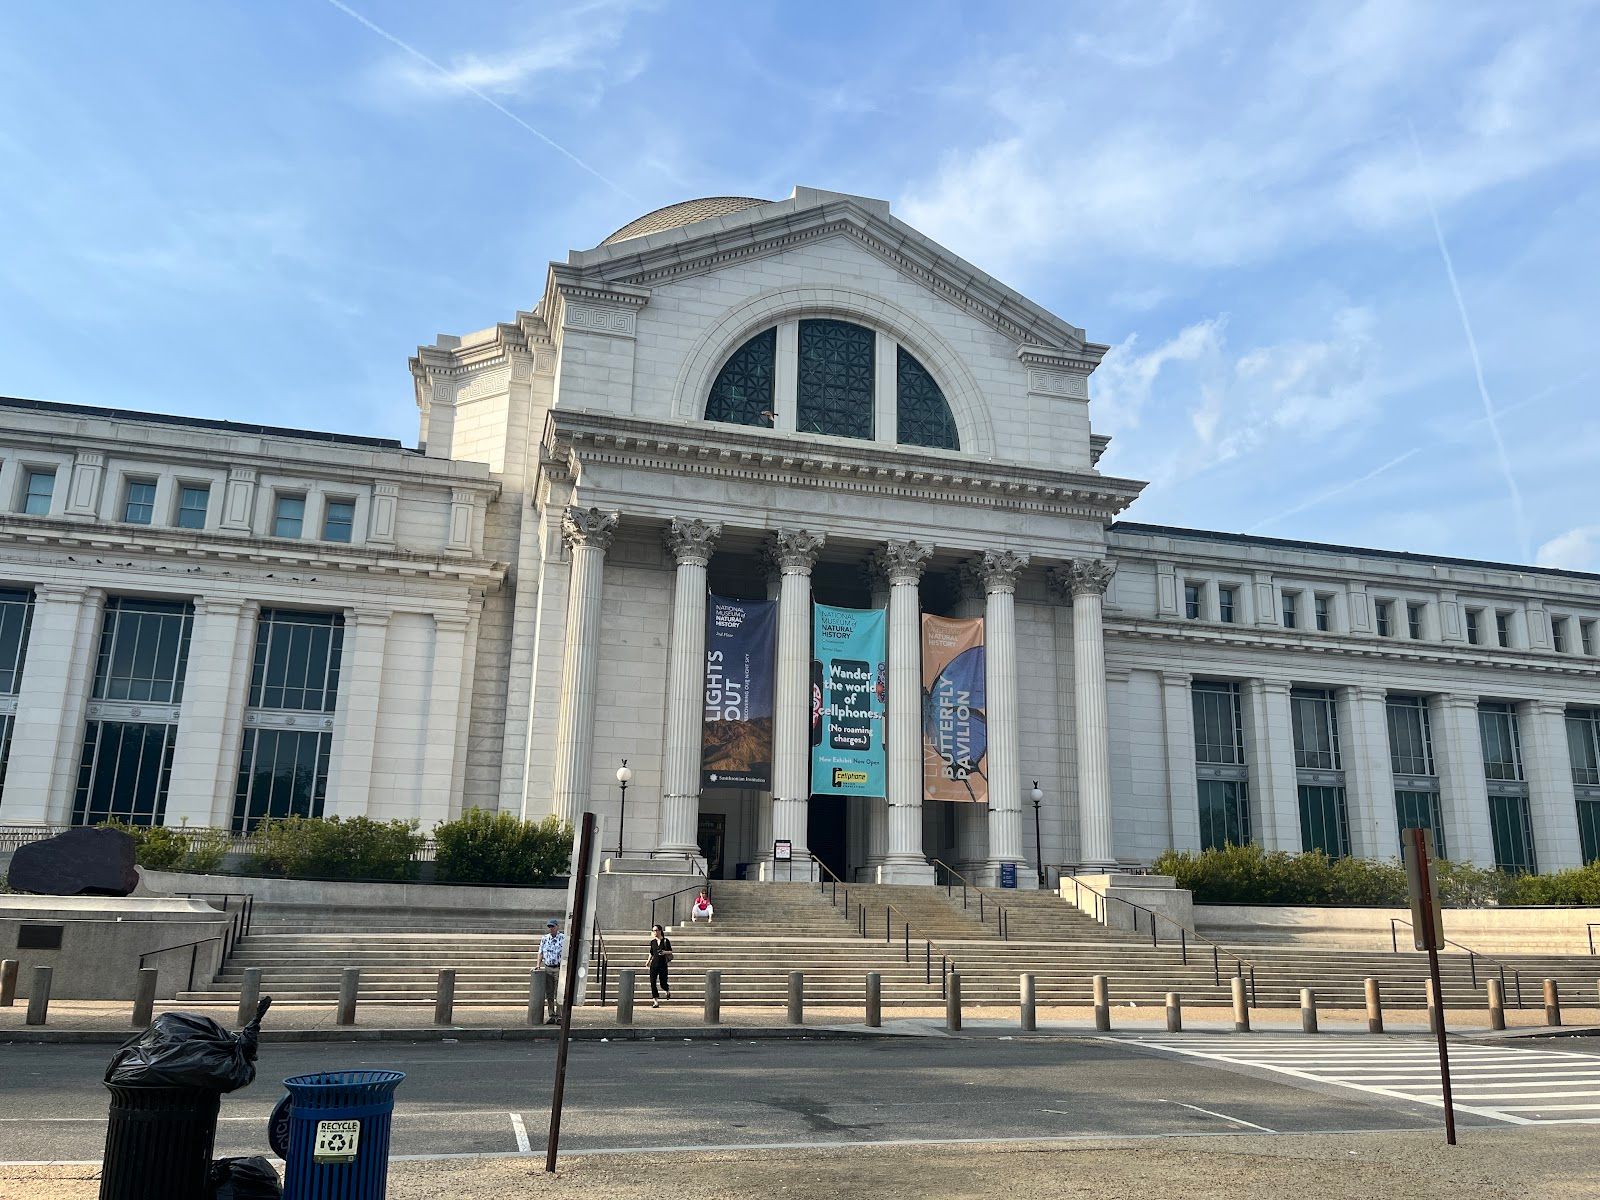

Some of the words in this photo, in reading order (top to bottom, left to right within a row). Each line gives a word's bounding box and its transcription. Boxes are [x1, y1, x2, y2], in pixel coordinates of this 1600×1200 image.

[716, 604, 744, 613] NATIONAL
[716, 615, 742, 623] NATURAL
[821, 610, 856, 621] NATIONAL
[716, 620, 740, 628] HISTORY
[821, 617, 851, 626] MUSEUM
[821, 624, 854, 633] NATURAL
[821, 631, 851, 640] HISTORY
[928, 632, 959, 642] NATURAL
[928, 639, 957, 648] HISTORY
[829, 664, 873, 681] Wander
[705, 650, 724, 722] LIGHTS
[823, 678, 843, 691] the
[845, 680, 877, 694] world
[724, 678, 741, 722] OUT
[843, 692, 858, 705] of
[818, 703, 882, 721] cellphones.
[828, 723, 842, 733] (No
[843, 725, 873, 737] roaming
[940, 674, 954, 780] BUTTERFLY
[834, 734, 867, 746] charges.)
[956, 690, 971, 780] PAVILION
[832, 756, 852, 764] Exhibit
[865, 758, 880, 767] Open
[924, 736, 938, 777] LIVE
[837, 772, 866, 780] cellphone
[321, 1122, 358, 1130] RECYCLE
